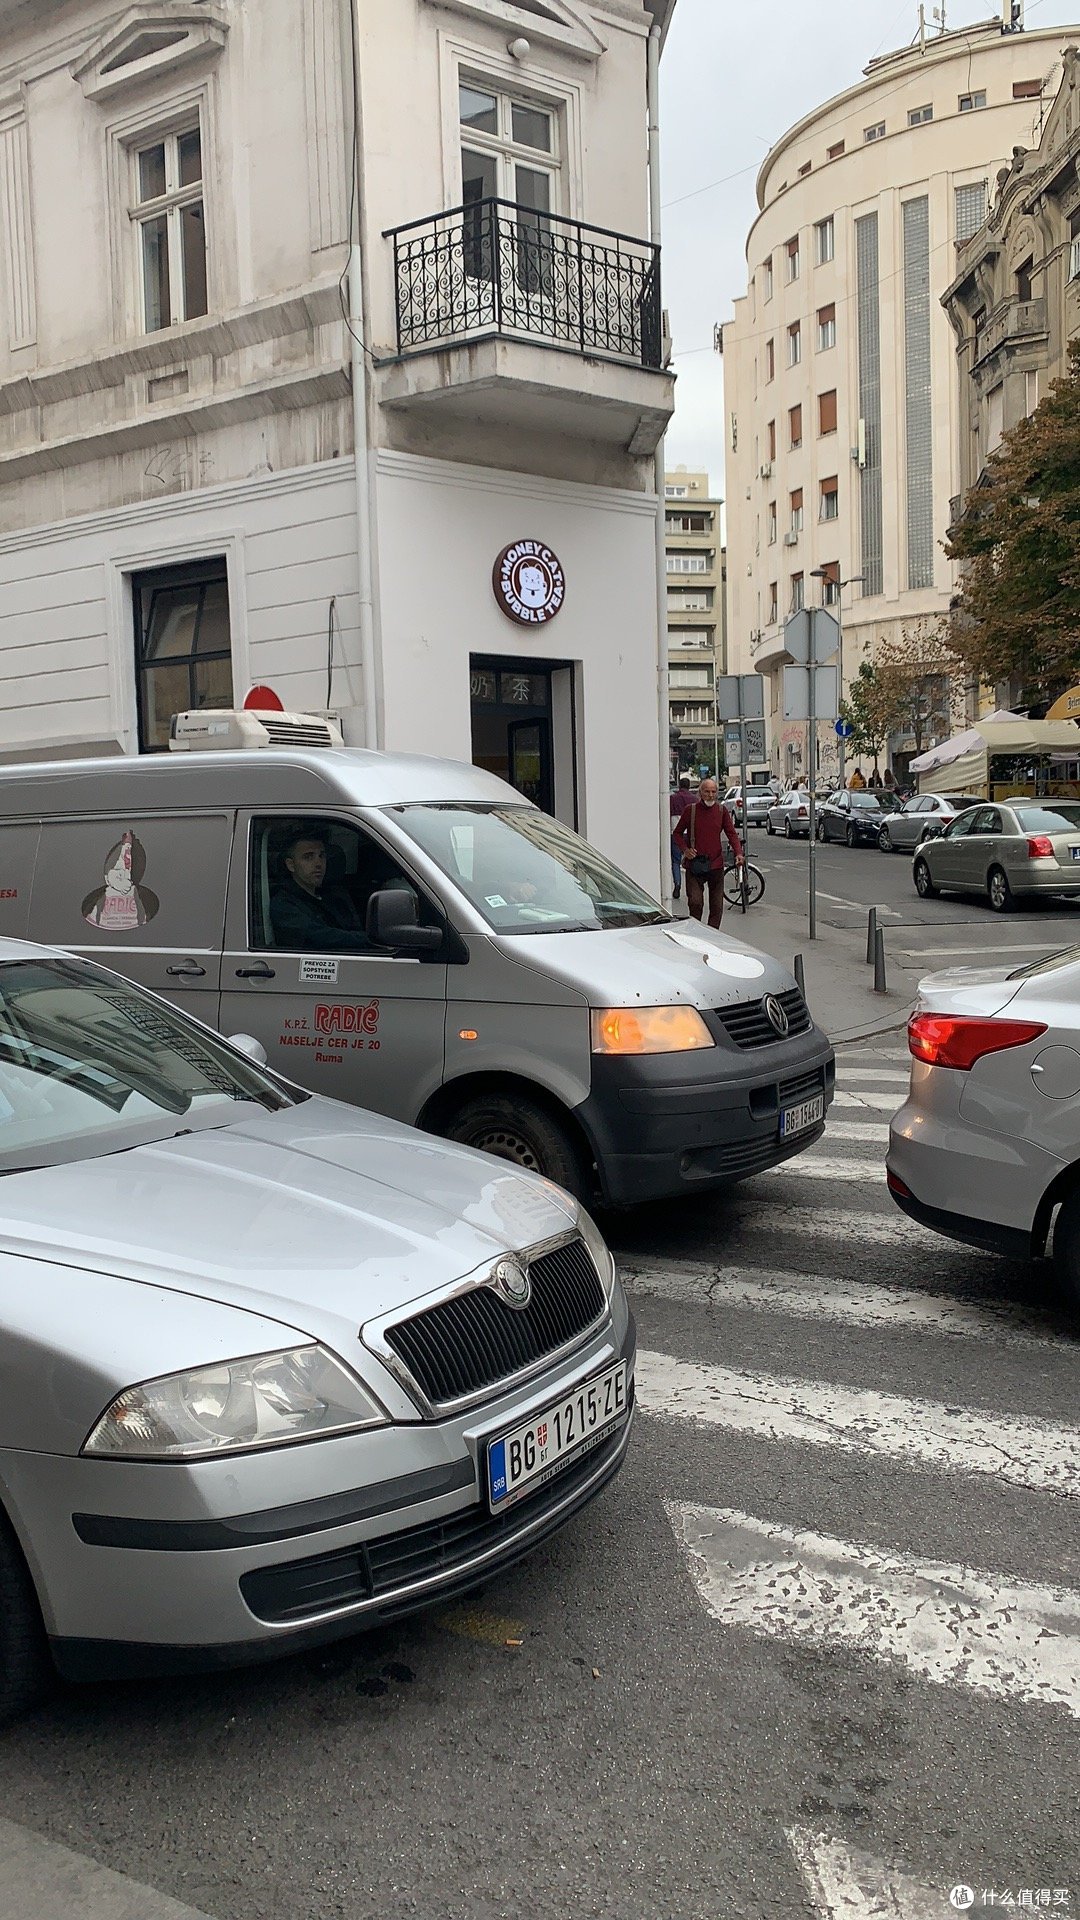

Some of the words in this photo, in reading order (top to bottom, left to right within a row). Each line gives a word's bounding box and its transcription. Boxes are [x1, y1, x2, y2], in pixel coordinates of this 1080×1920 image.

[501, 541, 542, 576] MONEY
[541, 549, 563, 581] CAT
[501, 580, 546, 622] BUBBLE
[545, 586, 564, 615] TEA
[315, 999, 379, 1034] RADIĆ
[280, 1035, 324, 1048] NASELJE
[327, 1037, 348, 1049] CER
[351, 1039, 365, 1050] JE
[368, 1040, 381, 1050] 20
[315, 1052, 343, 1063] Ruma
[785, 1110, 796, 1132] BG
[509, 1430, 536, 1482] BG
[552, 1370, 624, 1450] 1215-ZE
[493, 1476, 506, 1493] SRB
